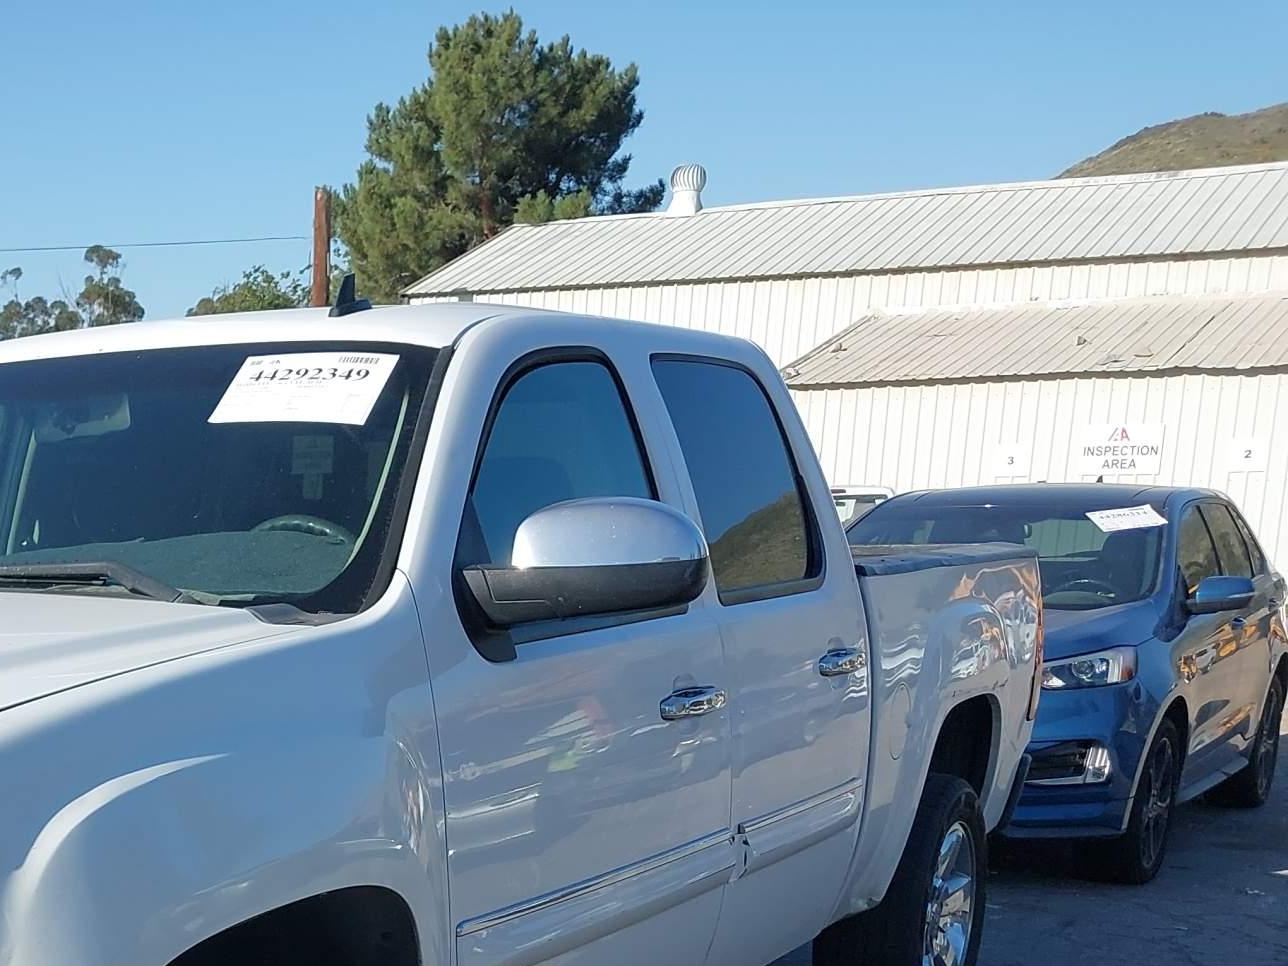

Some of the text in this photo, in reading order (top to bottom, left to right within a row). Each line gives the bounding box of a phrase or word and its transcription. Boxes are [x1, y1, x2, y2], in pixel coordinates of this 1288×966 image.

[249, 367, 371, 382] 44292349
[1083, 445, 1159, 457] INSPECTION
[1243, 449, 1252, 459] 2
[1007, 456, 1015, 466] 3
[1101, 458, 1137, 470] AREA
